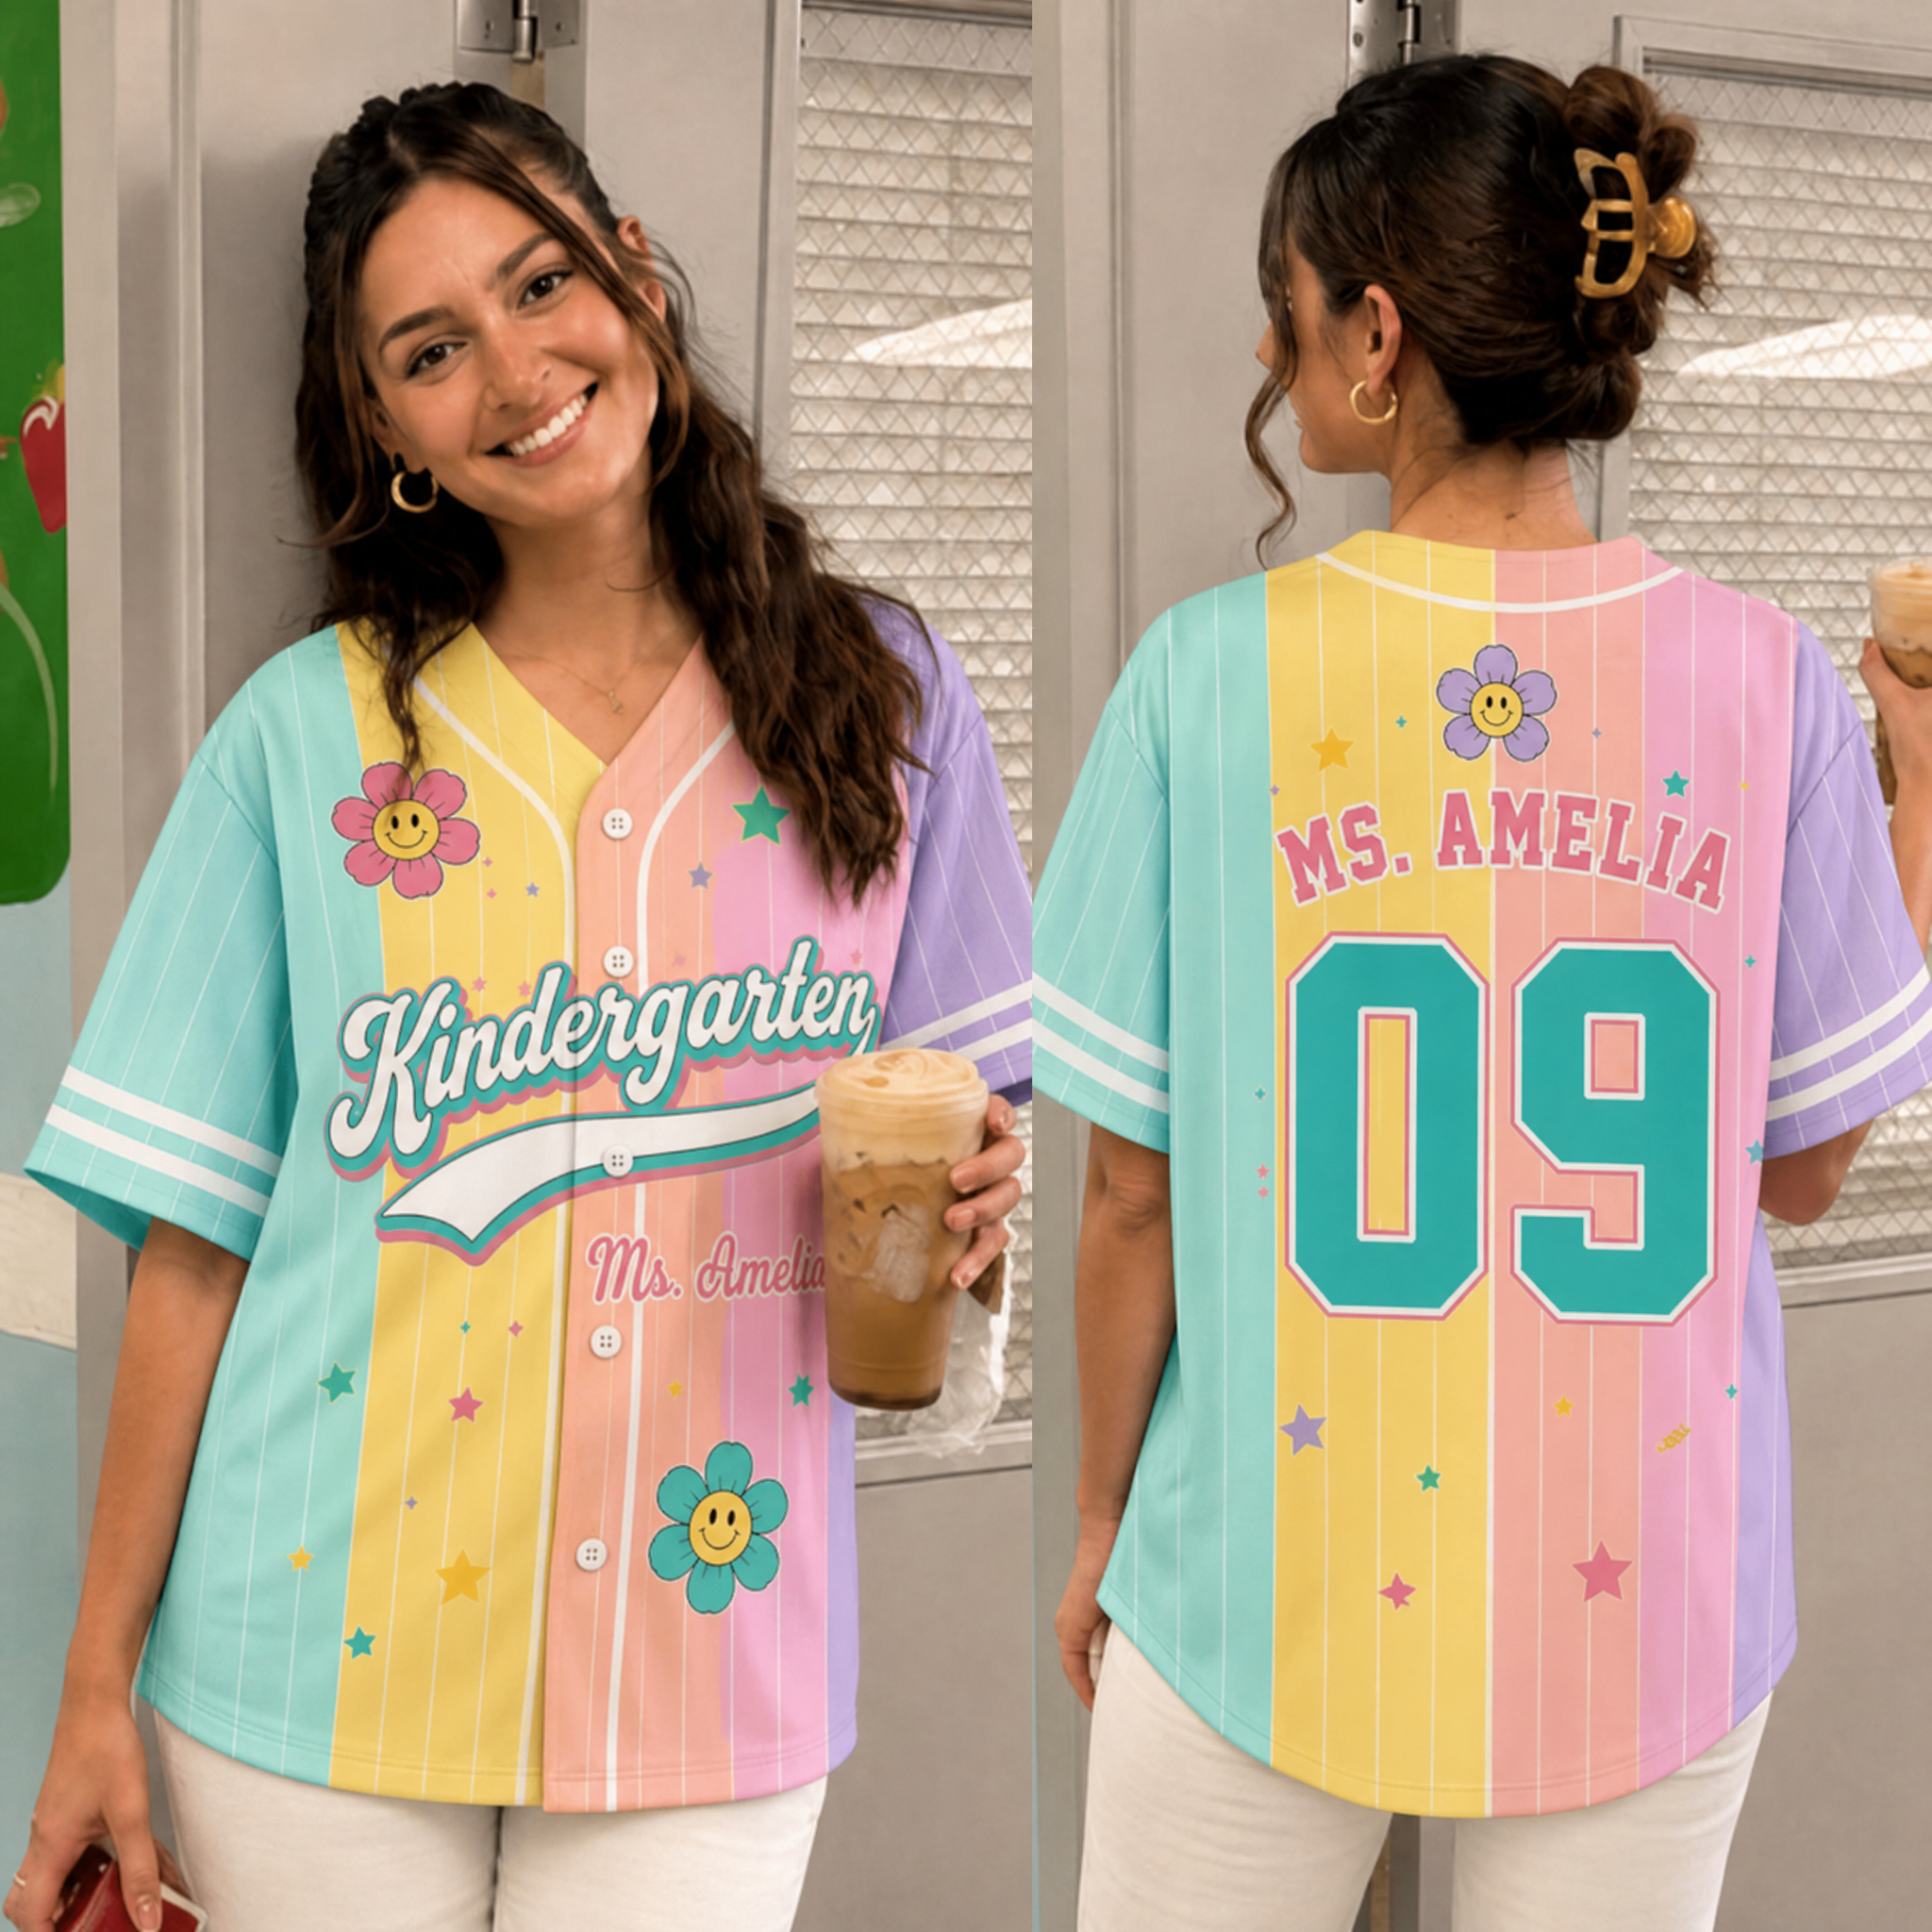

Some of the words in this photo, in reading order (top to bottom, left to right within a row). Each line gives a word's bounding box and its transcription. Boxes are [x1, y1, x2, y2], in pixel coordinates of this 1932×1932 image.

[1276, 802, 1412, 906] MS.
[1437, 788, 1730, 913] AMELIA
[325, 937, 879, 1166] Kindergarten
[1285, 931, 1720, 1326] 09
[586, 1233, 683, 1304] Ms.
[695, 1231, 824, 1301] Amelia
